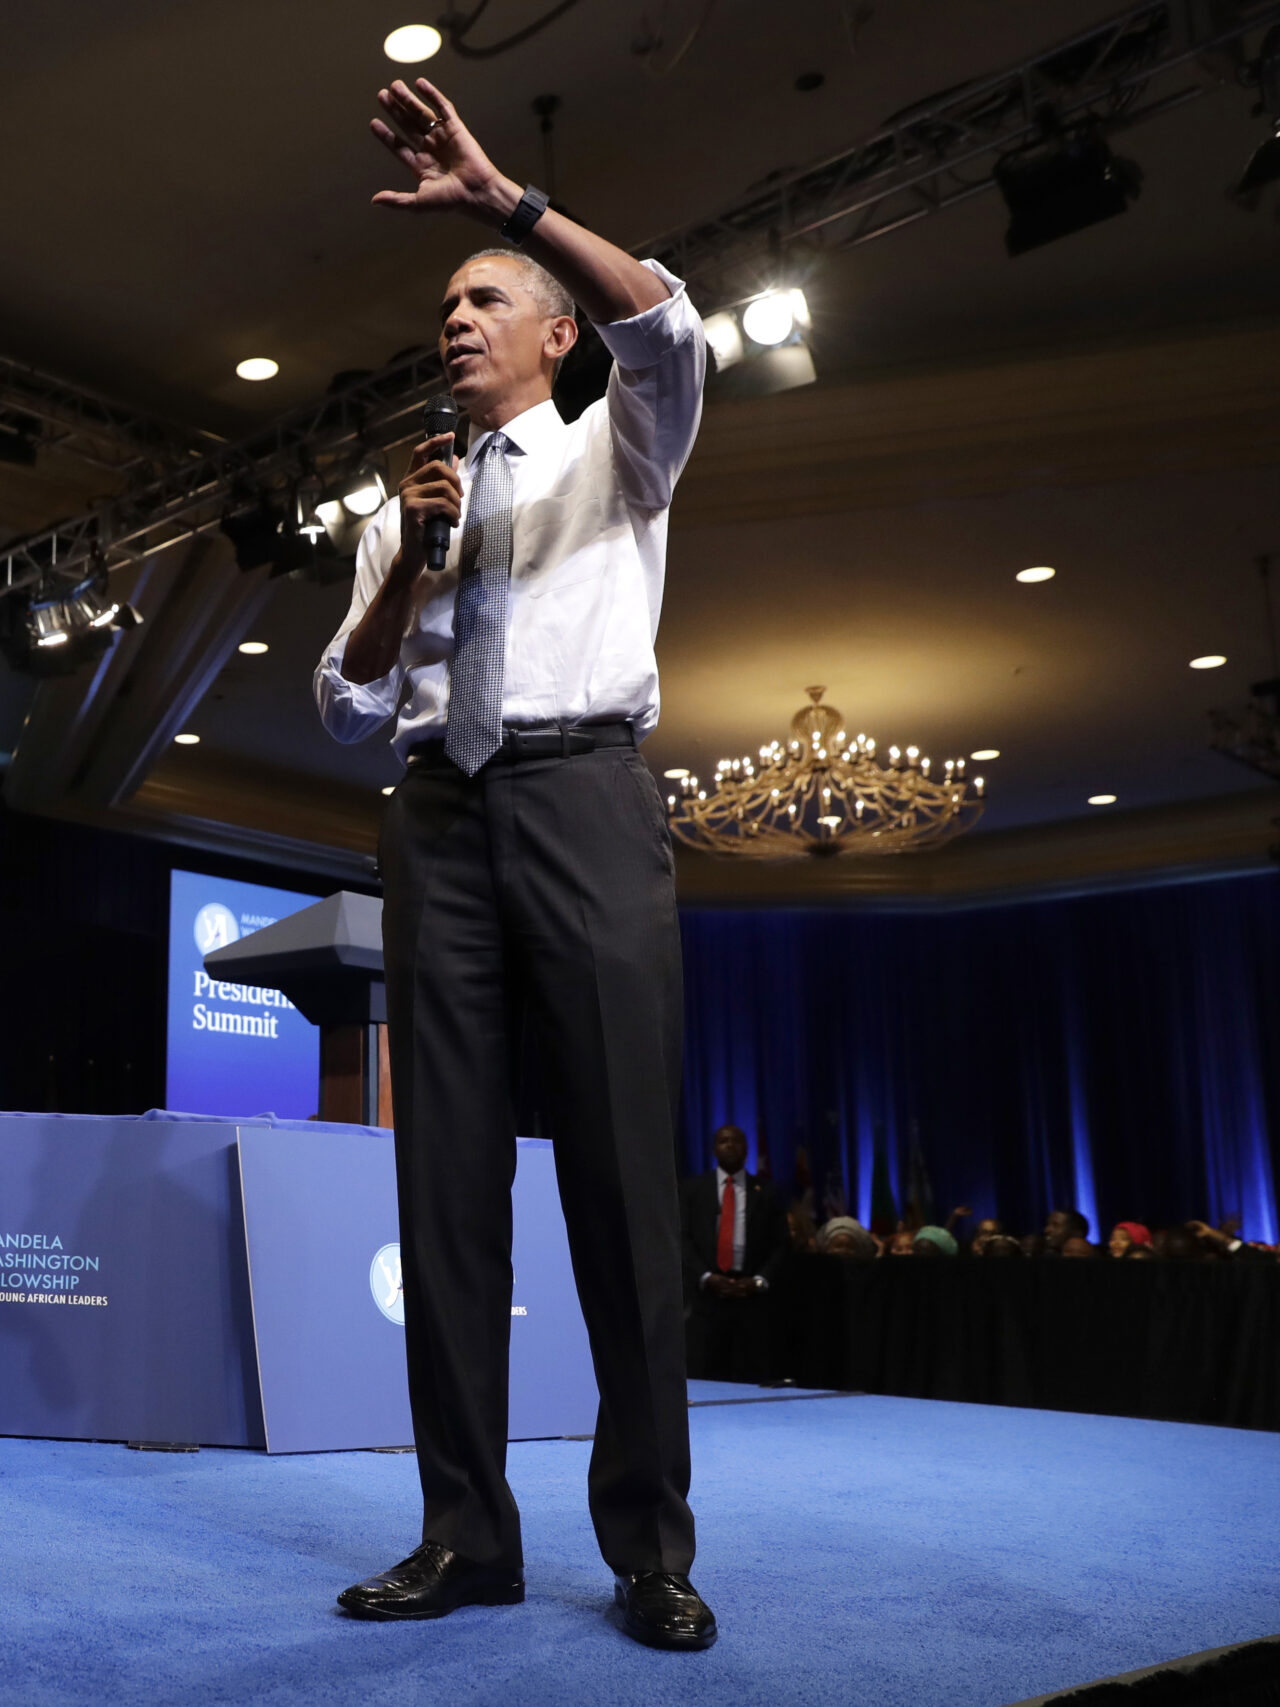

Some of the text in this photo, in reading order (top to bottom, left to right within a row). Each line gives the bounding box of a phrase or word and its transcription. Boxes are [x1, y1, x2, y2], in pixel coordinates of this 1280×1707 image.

[241, 912, 279, 928] MANDE
[192, 1003, 279, 1039] Summit
[27, 1293, 66, 1305] AFRICAN
[68, 1295, 108, 1306] LEADERS
